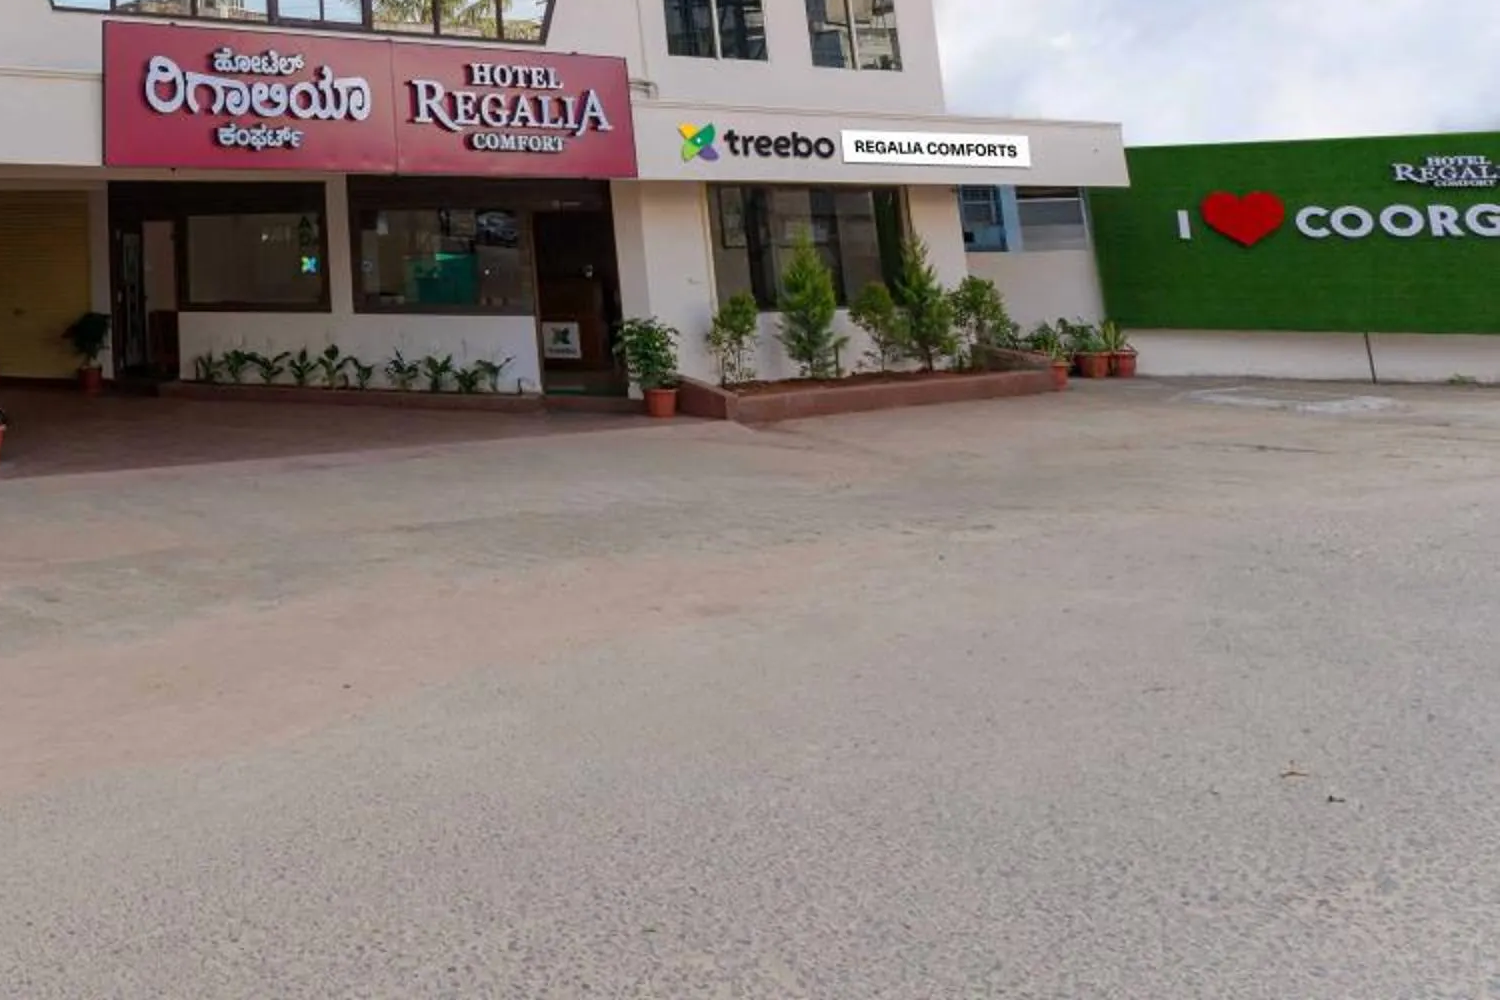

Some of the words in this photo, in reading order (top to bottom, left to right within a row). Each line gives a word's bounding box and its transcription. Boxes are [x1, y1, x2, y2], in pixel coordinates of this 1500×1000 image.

[470, 63, 564, 89] HOTEL
[411, 79, 613, 137] REGALIA
[472, 133, 564, 152] COMFORT
[723, 129, 835, 159] treebo
[854, 140, 925, 156] REGALIA
[926, 142, 1017, 158] COMFORTS
[1426, 155, 1492, 167] HOTEL
[1177, 210, 1191, 239] I
[1295, 204, 1500, 238] COORG
